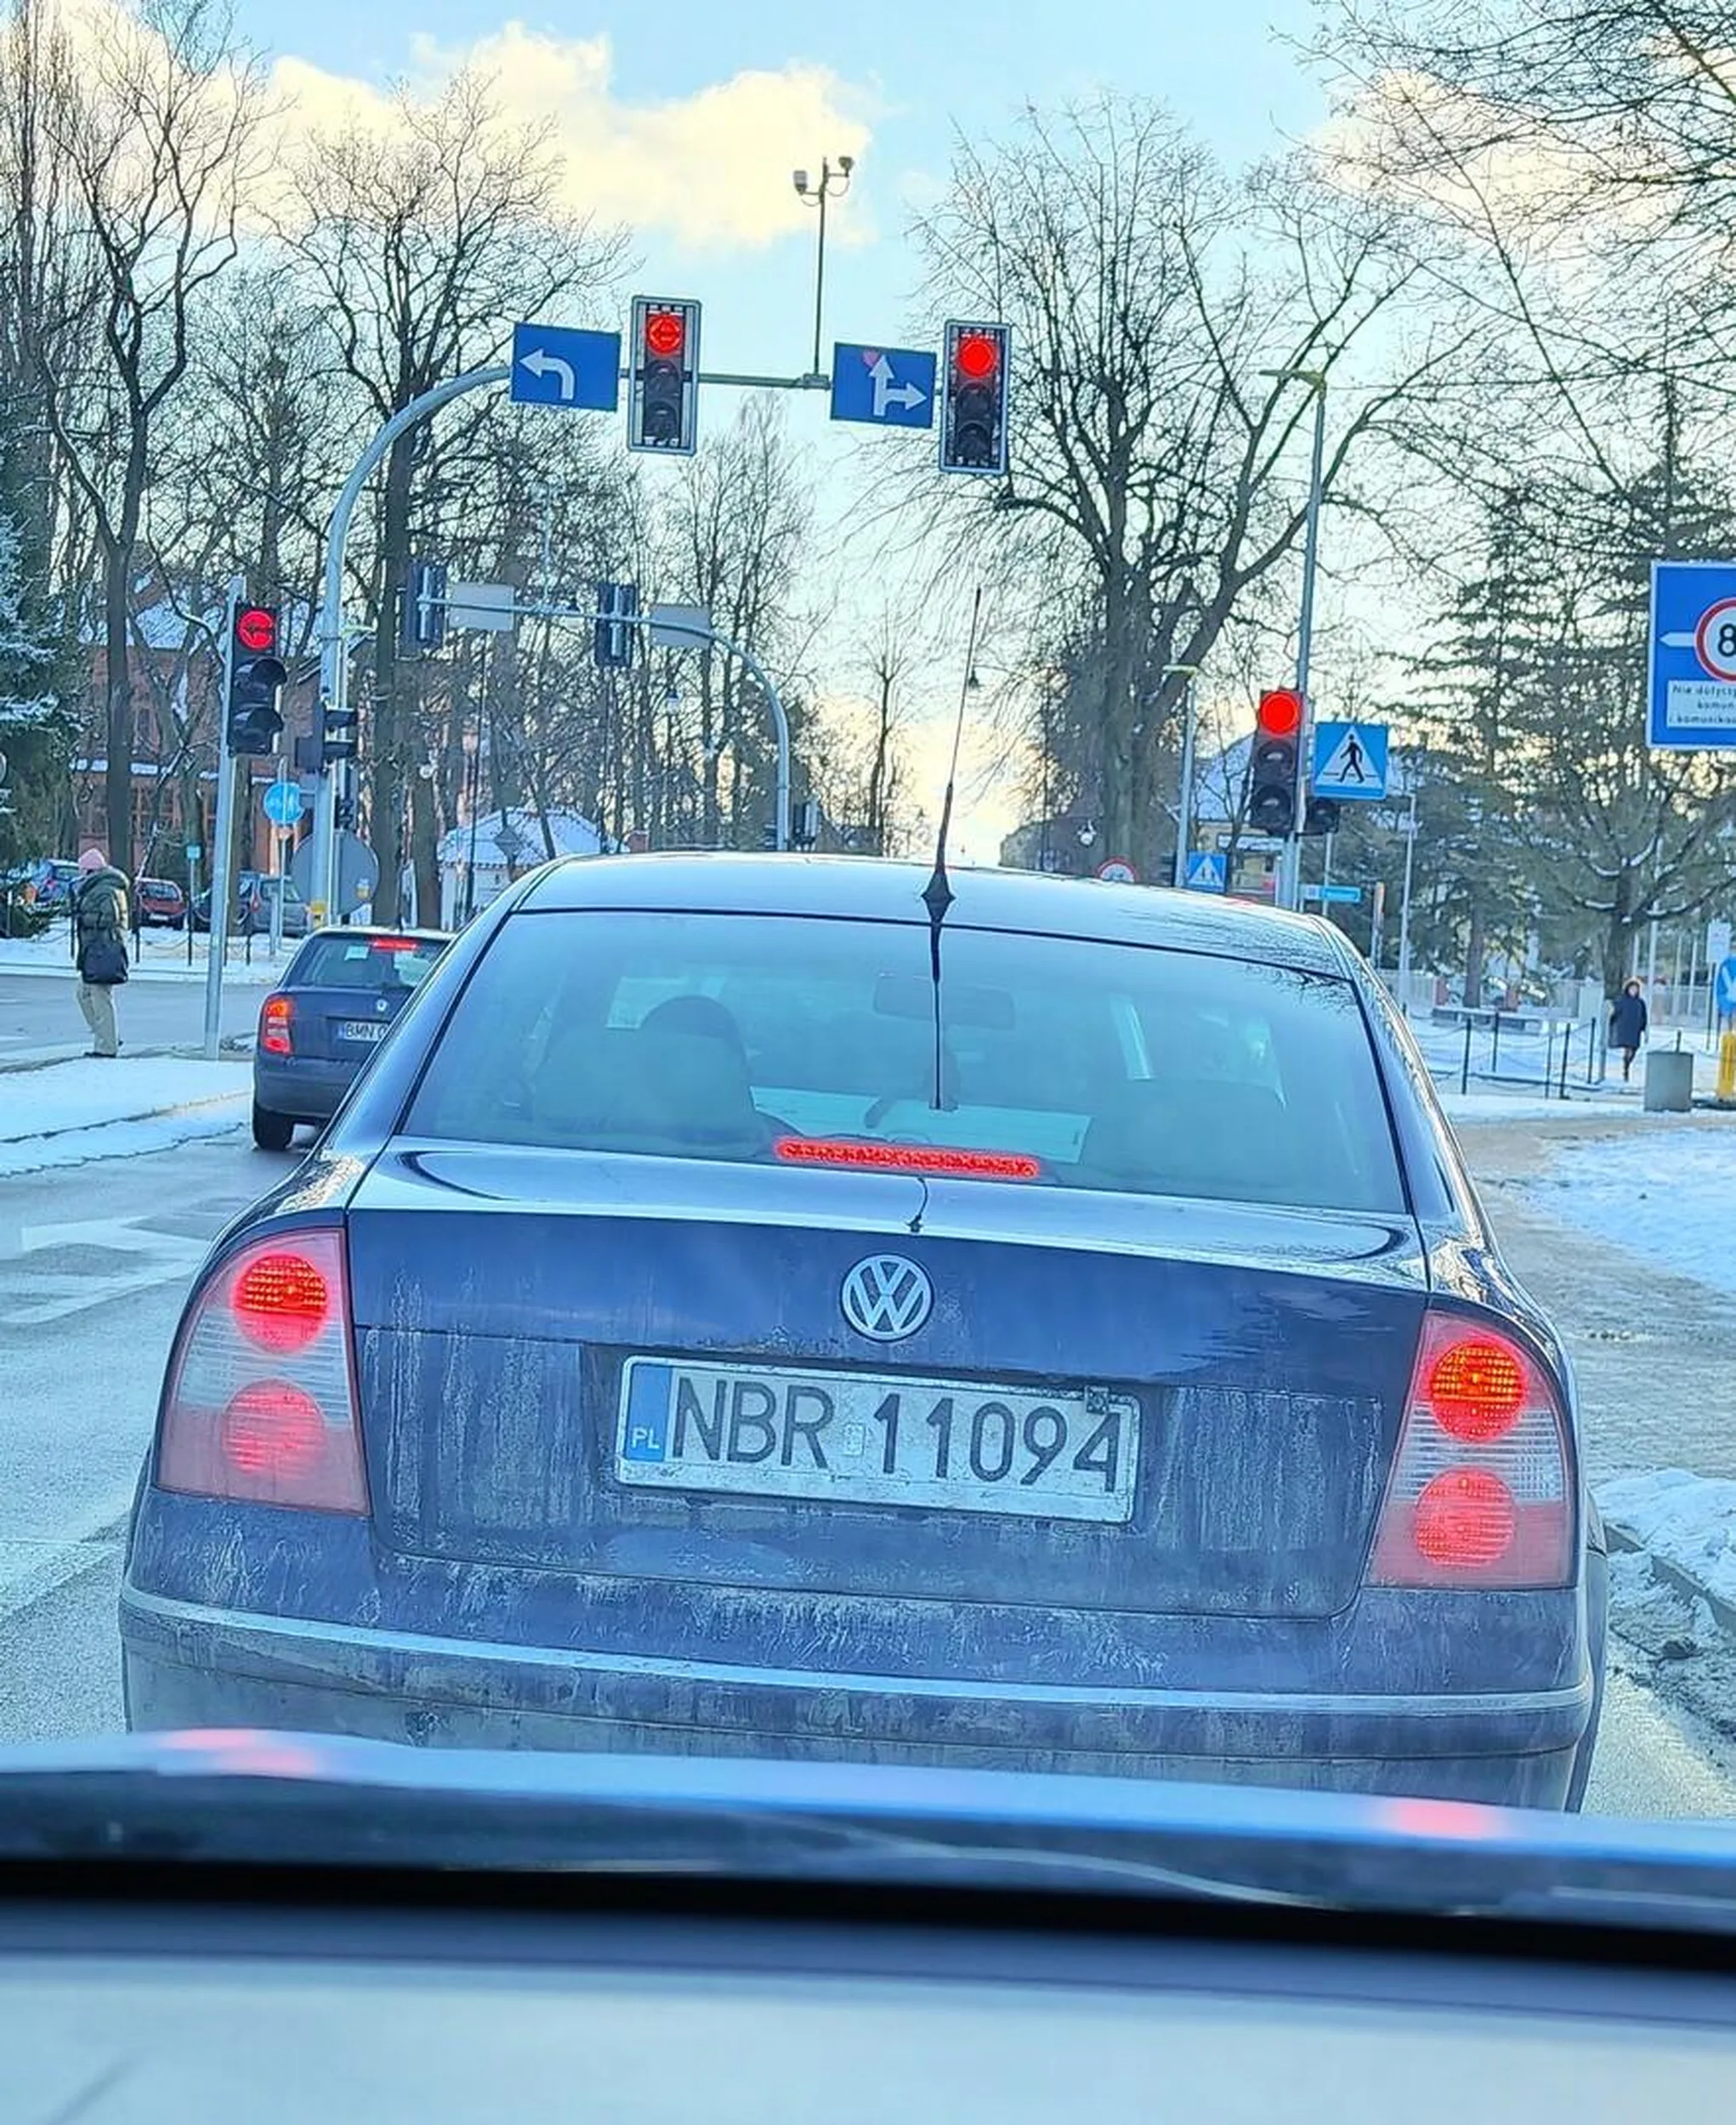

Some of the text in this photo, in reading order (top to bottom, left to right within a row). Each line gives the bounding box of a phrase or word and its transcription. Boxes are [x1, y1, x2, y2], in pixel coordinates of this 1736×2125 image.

[1718, 624, 1736, 657] 8
[631, 1425, 661, 1450] PL
[672, 1377, 1120, 1493] NBR 11094
